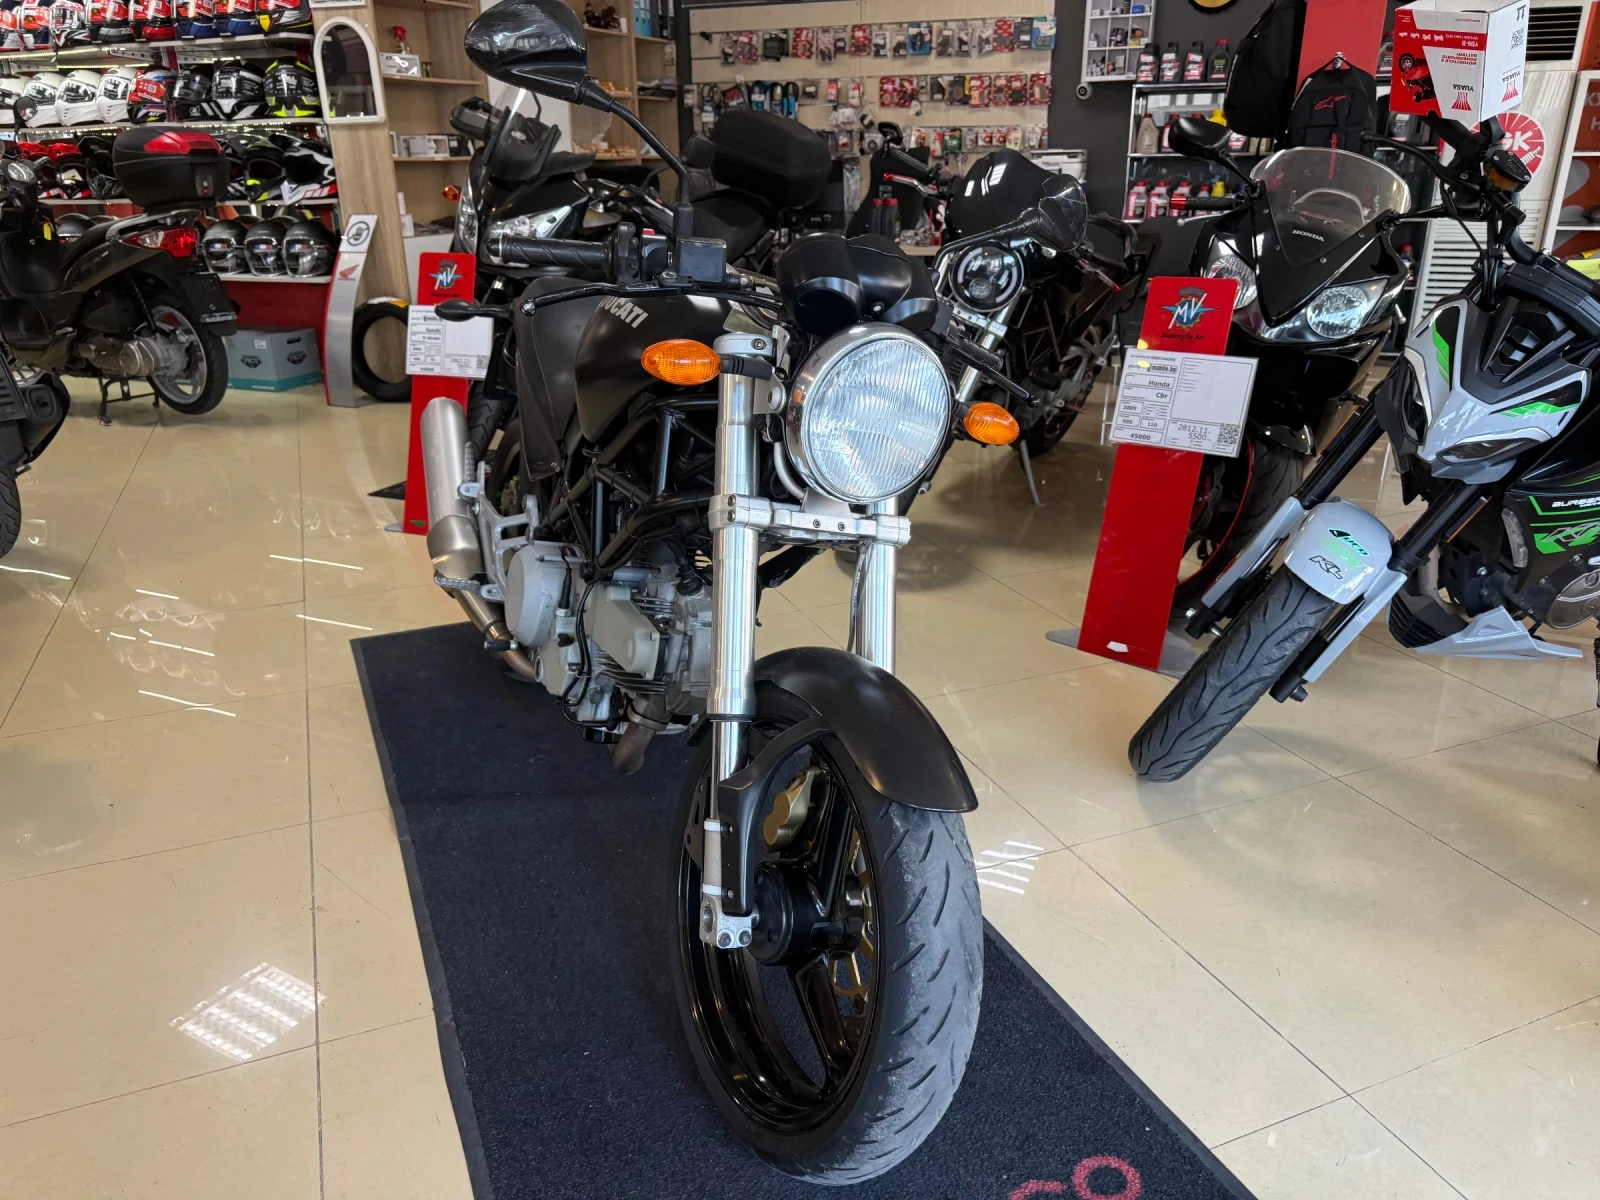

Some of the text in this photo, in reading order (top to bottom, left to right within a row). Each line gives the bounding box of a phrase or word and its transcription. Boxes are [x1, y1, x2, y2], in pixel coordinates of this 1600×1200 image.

[1502, 70, 1521, 83] YUASA
[1452, 84, 1474, 92] YUASA
[1502, 131, 1533, 151] GK
[1292, 229, 1325, 242] HONDA
[1168, 293, 1208, 329] MV
[1161, 331, 1193, 341] Motorcycle
[1148, 379, 1171, 388] Honda
[1155, 392, 1169, 400] Cbr
[1129, 433, 1151, 441] 45000
[1187, 432, 1207, 441] 5500
